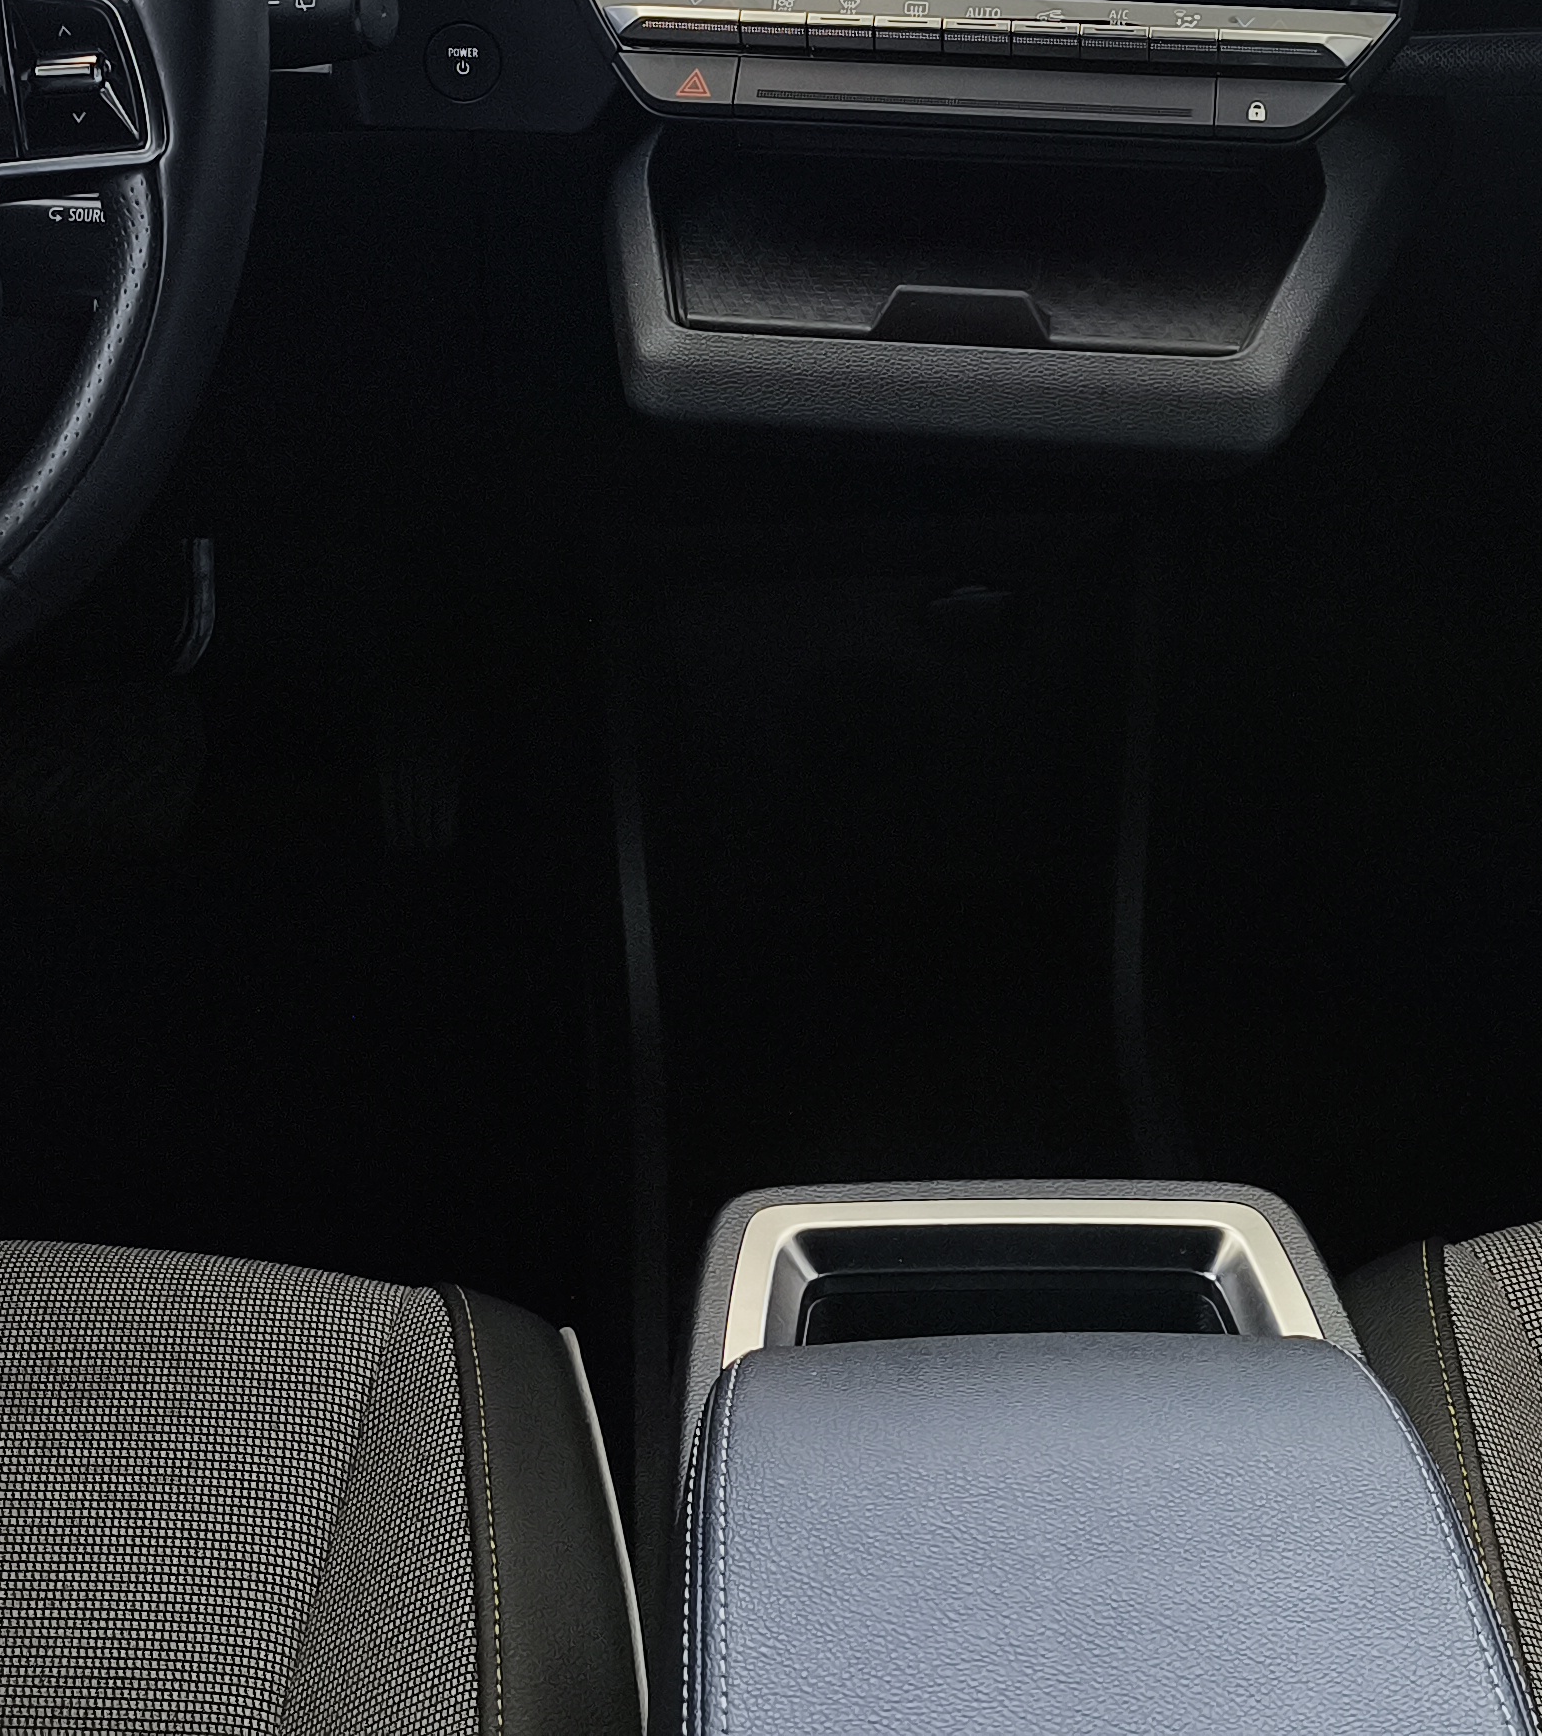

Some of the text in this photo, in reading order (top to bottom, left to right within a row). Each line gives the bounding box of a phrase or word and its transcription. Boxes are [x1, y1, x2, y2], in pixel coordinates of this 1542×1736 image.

[965, 7, 1001, 18] AUTO
[1109, 9, 1129, 20] A/C
[448, 47, 479, 58] POWER
